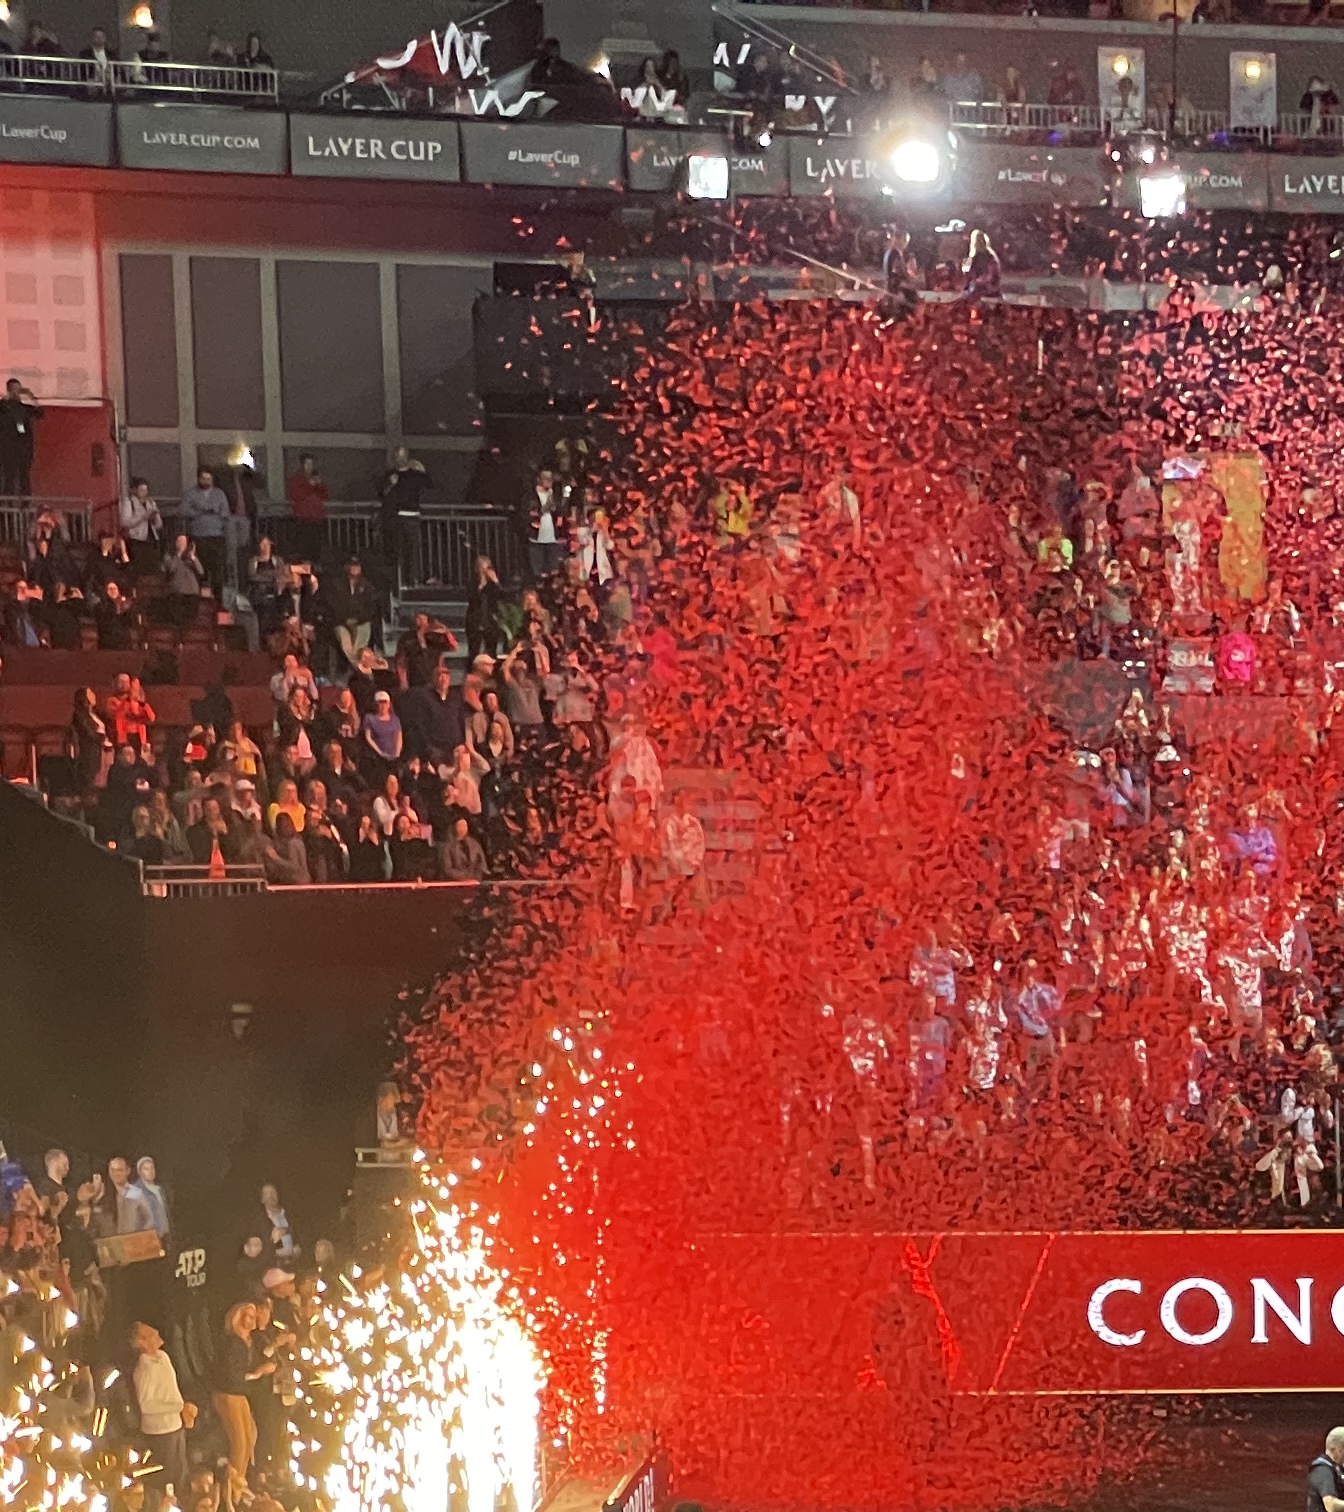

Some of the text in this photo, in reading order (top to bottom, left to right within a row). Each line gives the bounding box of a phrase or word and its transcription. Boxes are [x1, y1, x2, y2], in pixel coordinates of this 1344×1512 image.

[143, 131, 190, 146] LAVER
[308, 136, 442, 161] LAVER CUP
[508, 149, 579, 166] #LaverCup
[175, 1248, 206, 1278] ATP
